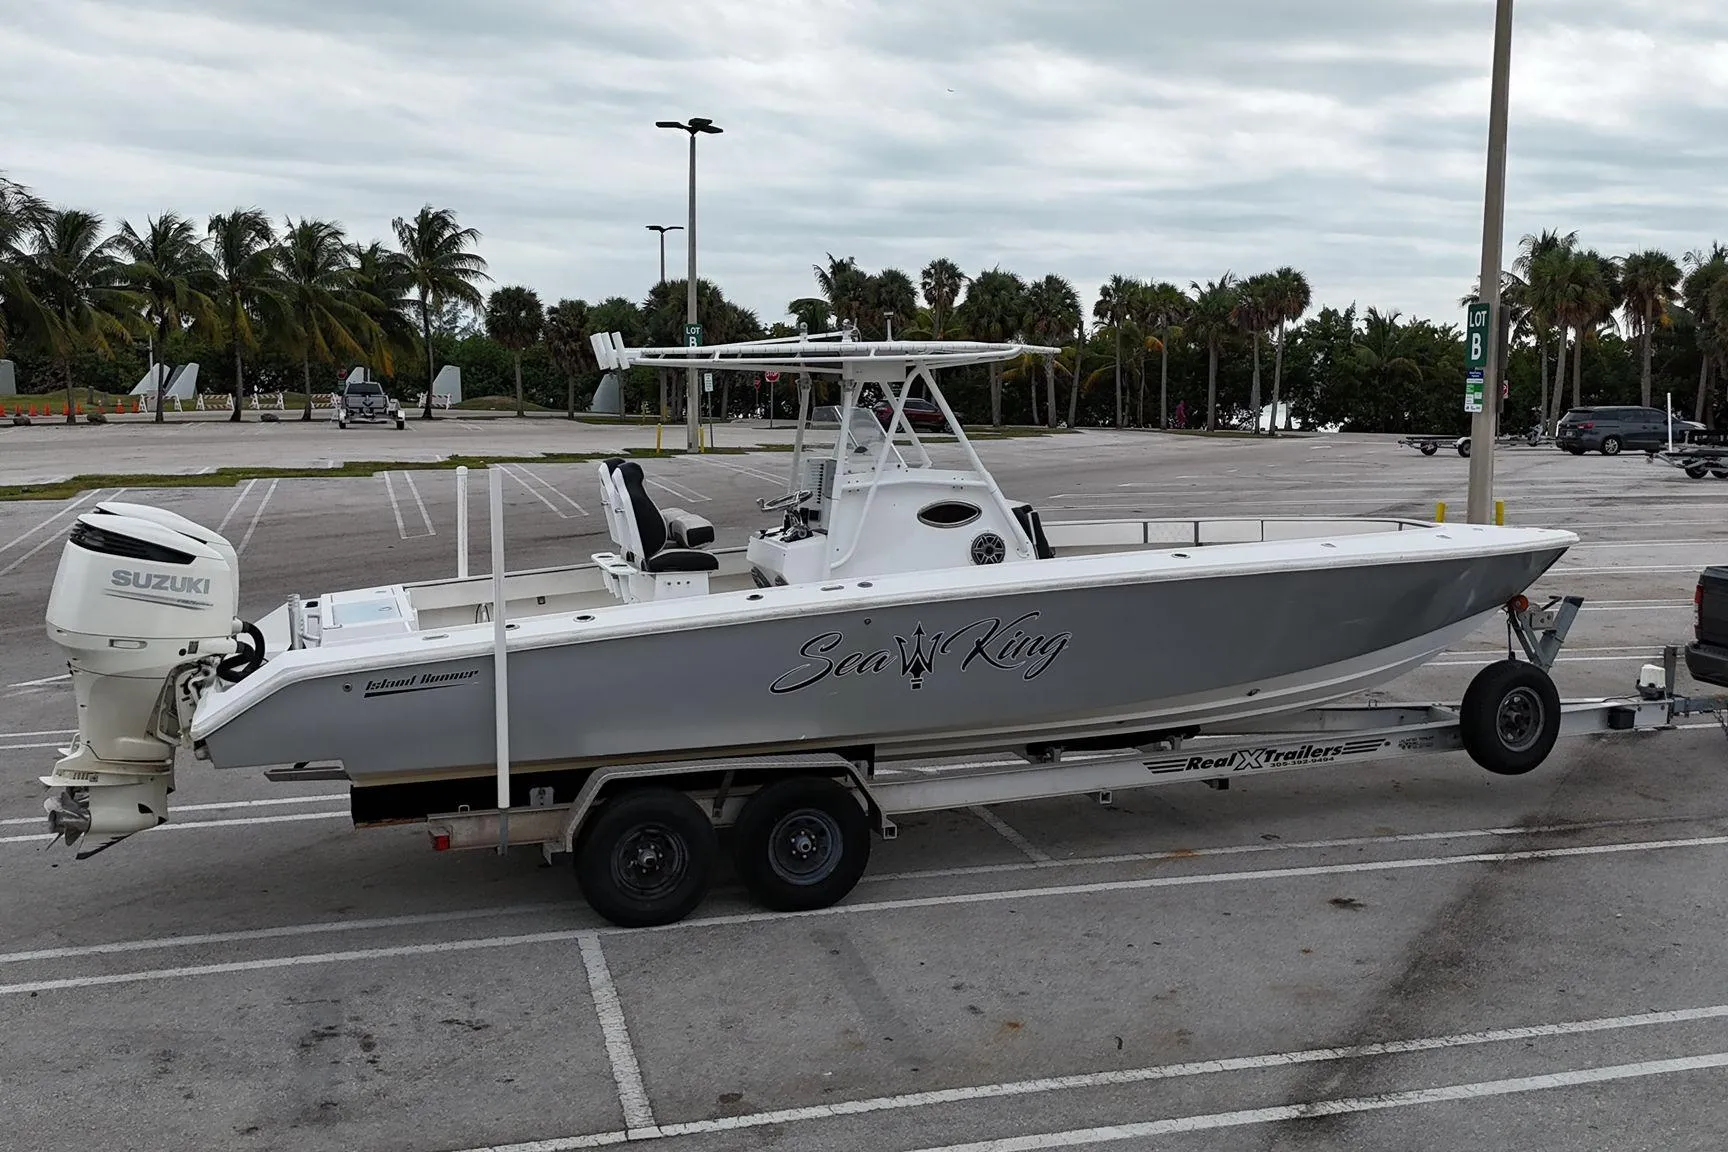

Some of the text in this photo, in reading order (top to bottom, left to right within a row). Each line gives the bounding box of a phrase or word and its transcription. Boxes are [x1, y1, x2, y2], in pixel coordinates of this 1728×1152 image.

[686, 327, 700, 335] LOT
[1469, 311, 1487, 328] LOT
[689, 336, 698, 348] B
[1471, 332, 1482, 361] B
[111, 569, 210, 594] SUZUKI
[769, 611, 1072, 694] Sea King
[365, 670, 479, 691] Island Runner
[1185, 753, 1237, 771] Real
[1264, 744, 1344, 763] Trailers
